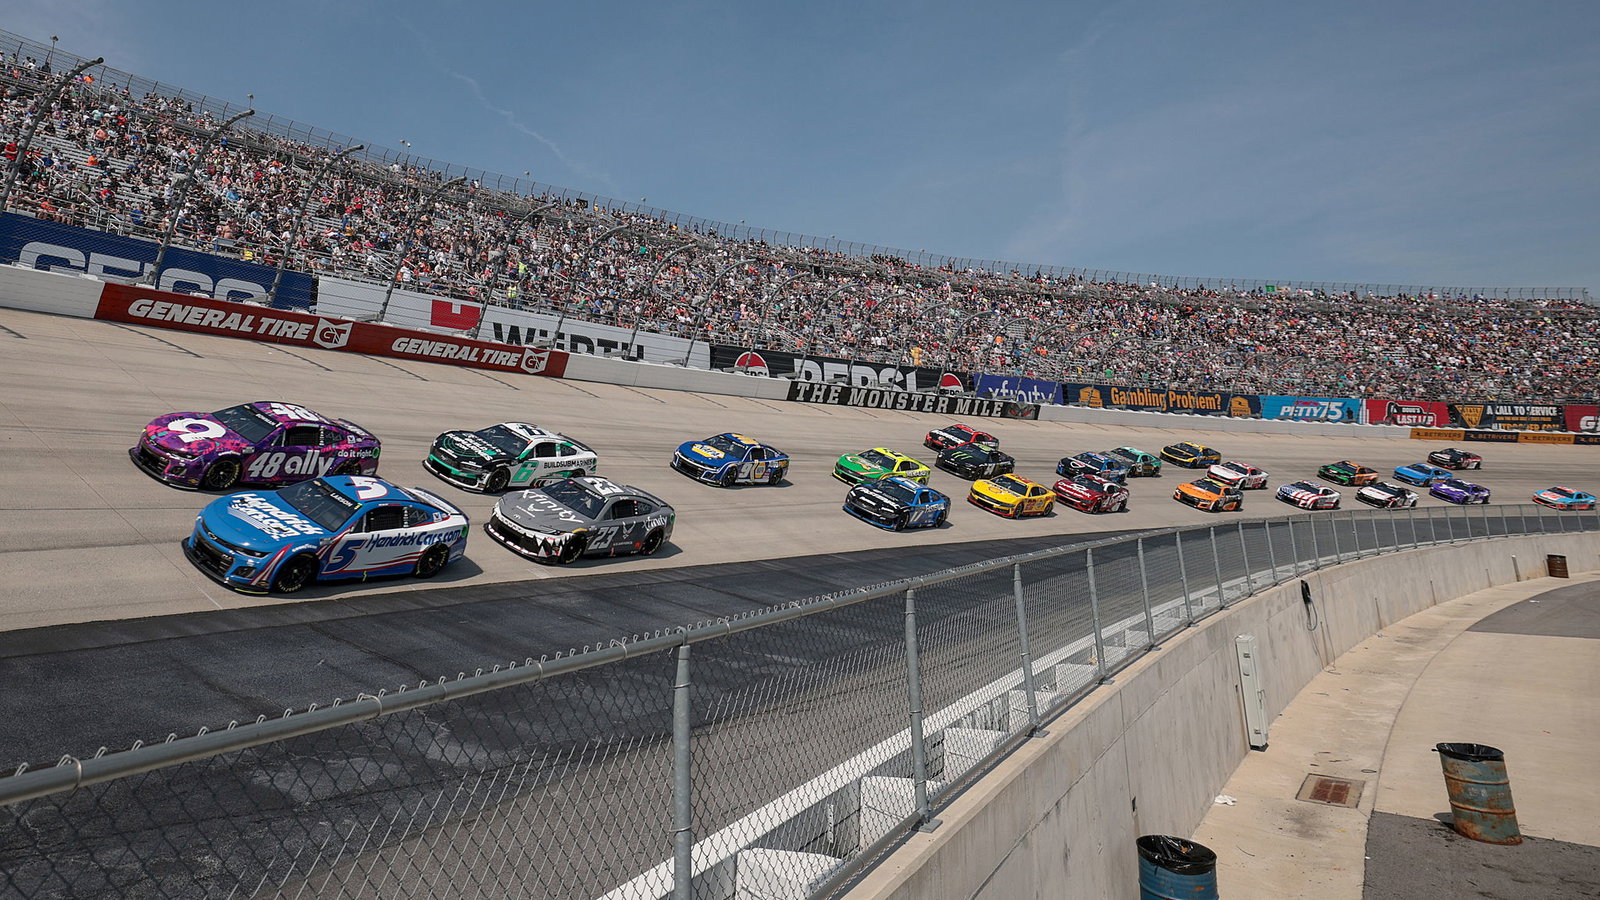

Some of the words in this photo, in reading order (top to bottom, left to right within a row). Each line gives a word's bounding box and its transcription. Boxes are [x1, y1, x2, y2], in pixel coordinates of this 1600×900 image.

[128, 299, 255, 333] GENERAL
[256, 317, 314, 340] TIRE
[391, 337, 479, 361] GENERAL
[480, 348, 522, 367] TIRE
[796, 382, 842, 404] THE
[847, 388, 949, 413] MONSTER
[954, 398, 1004, 417] MILE
[1110, 387, 1167, 411] Gambling
[1168, 390, 1222, 410] Problem?
[1320, 401, 1345, 420] 75
[1396, 414, 1417, 424] LAST
[1486, 406, 1493, 415] A
[1495, 406, 1513, 415] CALL
[1514, 406, 1526, 416] TO
[1526, 406, 1558, 416] SERVICE
[1420, 431, 1462, 439] BETRIVERS
[1531, 434, 1573, 442] BETRIVERS
[248, 452, 286, 478] 48
[284, 450, 336, 478] ally
[338, 450, 349, 458] do
[350, 449, 356, 458] it
[511, 460, 540, 483] 6
[739, 462, 753, 478] 9
[1137, 463, 1143, 472] 3
[350, 476, 388, 500] 5
[330, 492, 353, 507] LARSON
[517, 489, 585, 524] xfinity
[641, 513, 668, 531] xfinity
[588, 526, 619, 550] 23
[322, 538, 369, 575] 5
